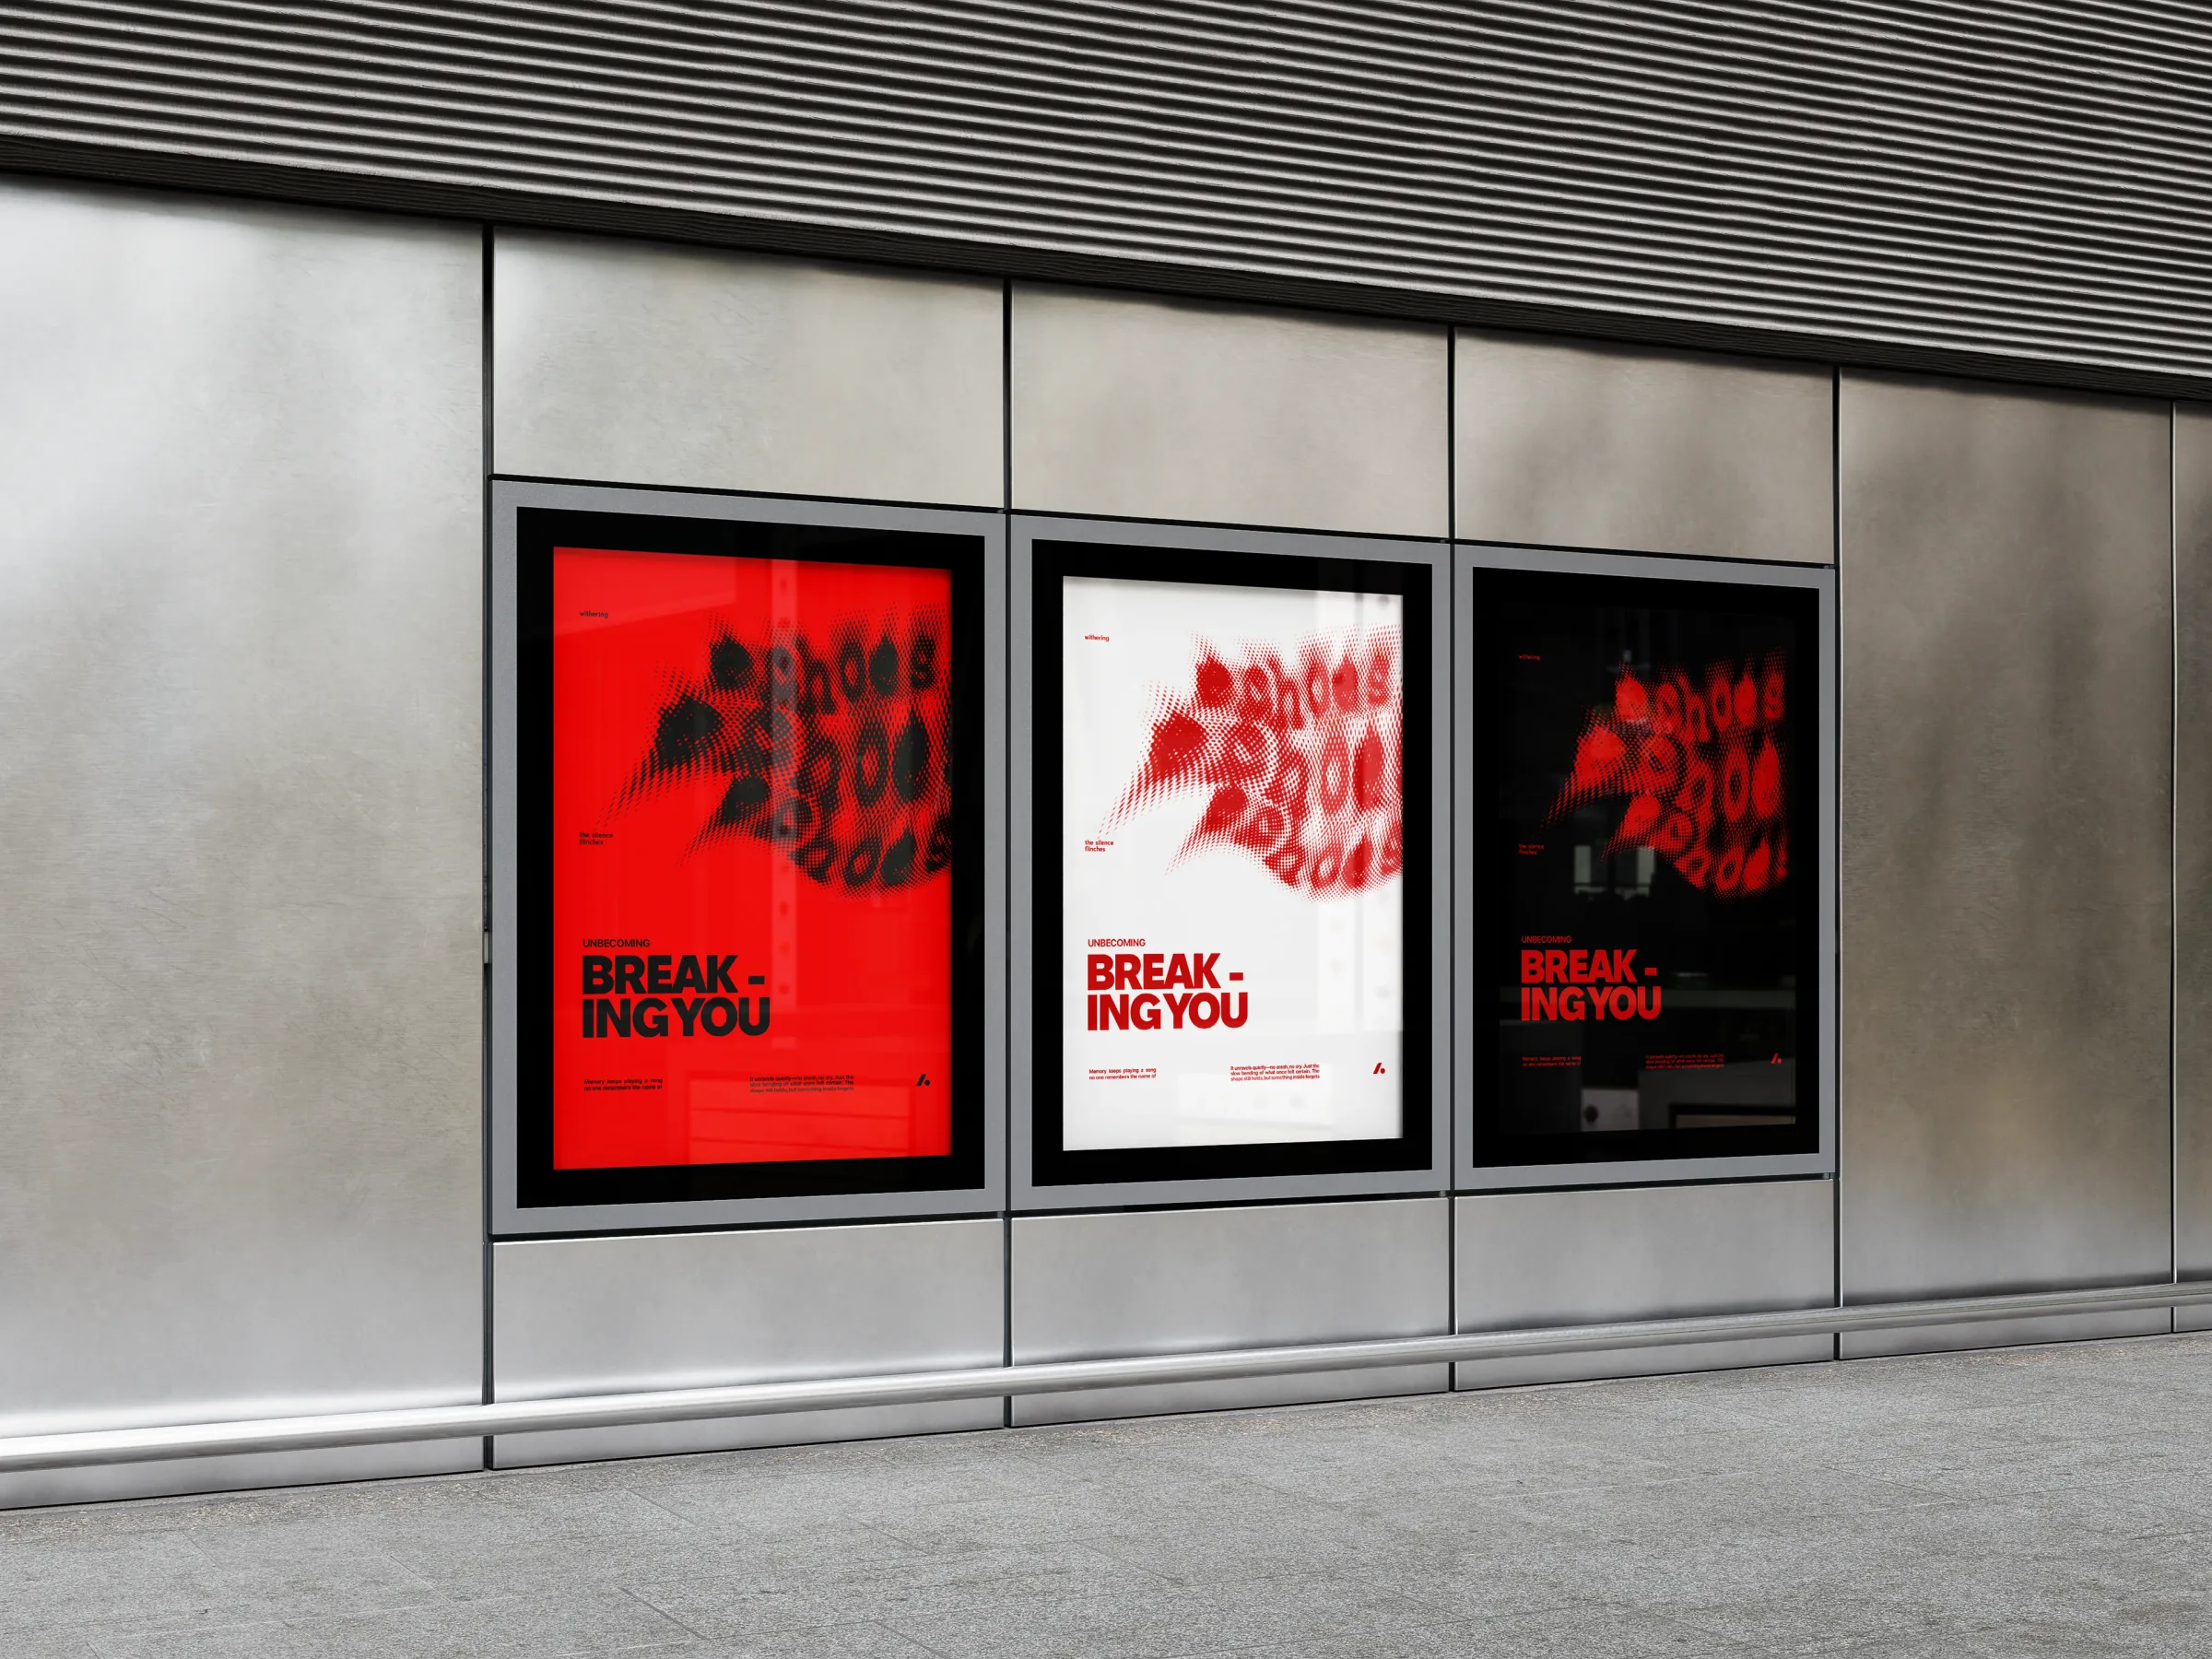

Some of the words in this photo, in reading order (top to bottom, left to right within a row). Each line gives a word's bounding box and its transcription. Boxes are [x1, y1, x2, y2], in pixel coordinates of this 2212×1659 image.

[579, 610, 608, 619] withering
[1085, 634, 1110, 642] withering
[582, 938, 651, 948] UNBECOMING
[1088, 938, 1146, 947] UNBECOMING
[1522, 935, 1572, 944] UNBECOMING
